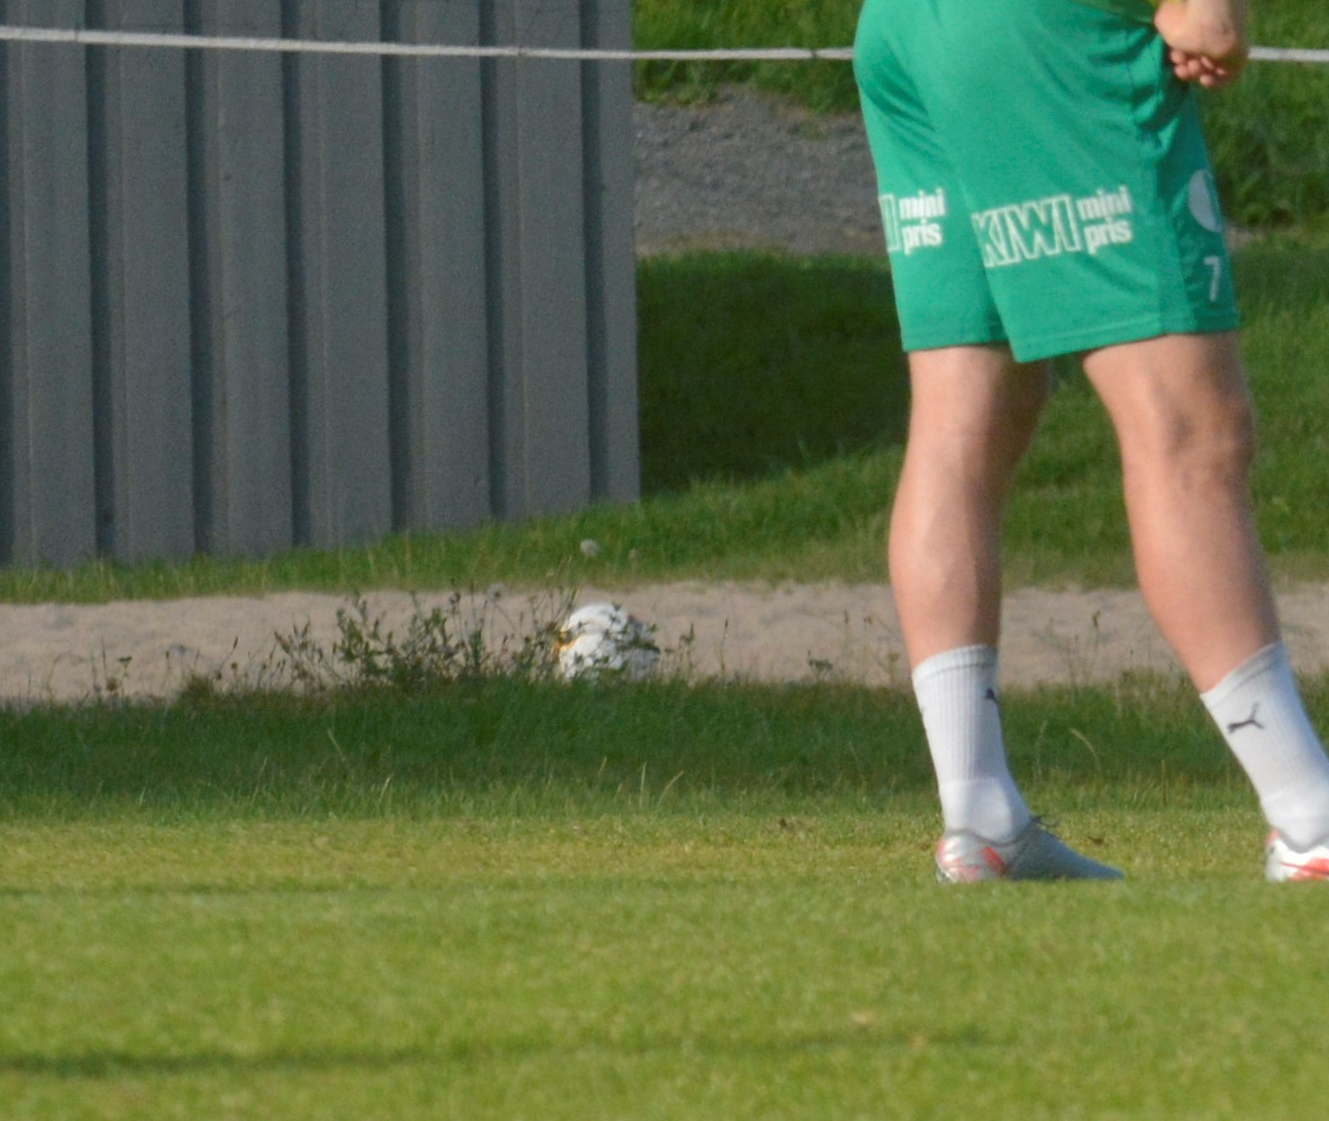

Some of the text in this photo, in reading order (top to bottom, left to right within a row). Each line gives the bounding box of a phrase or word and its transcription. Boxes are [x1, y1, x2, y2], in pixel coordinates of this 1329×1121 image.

[899, 188, 946, 220] mini
[902, 218, 942, 255] pris
[971, 194, 1083, 268] KIWI
[1075, 184, 1132, 221] mini
[1083, 217, 1133, 255] pris
[1203, 255, 1222, 302] 7
